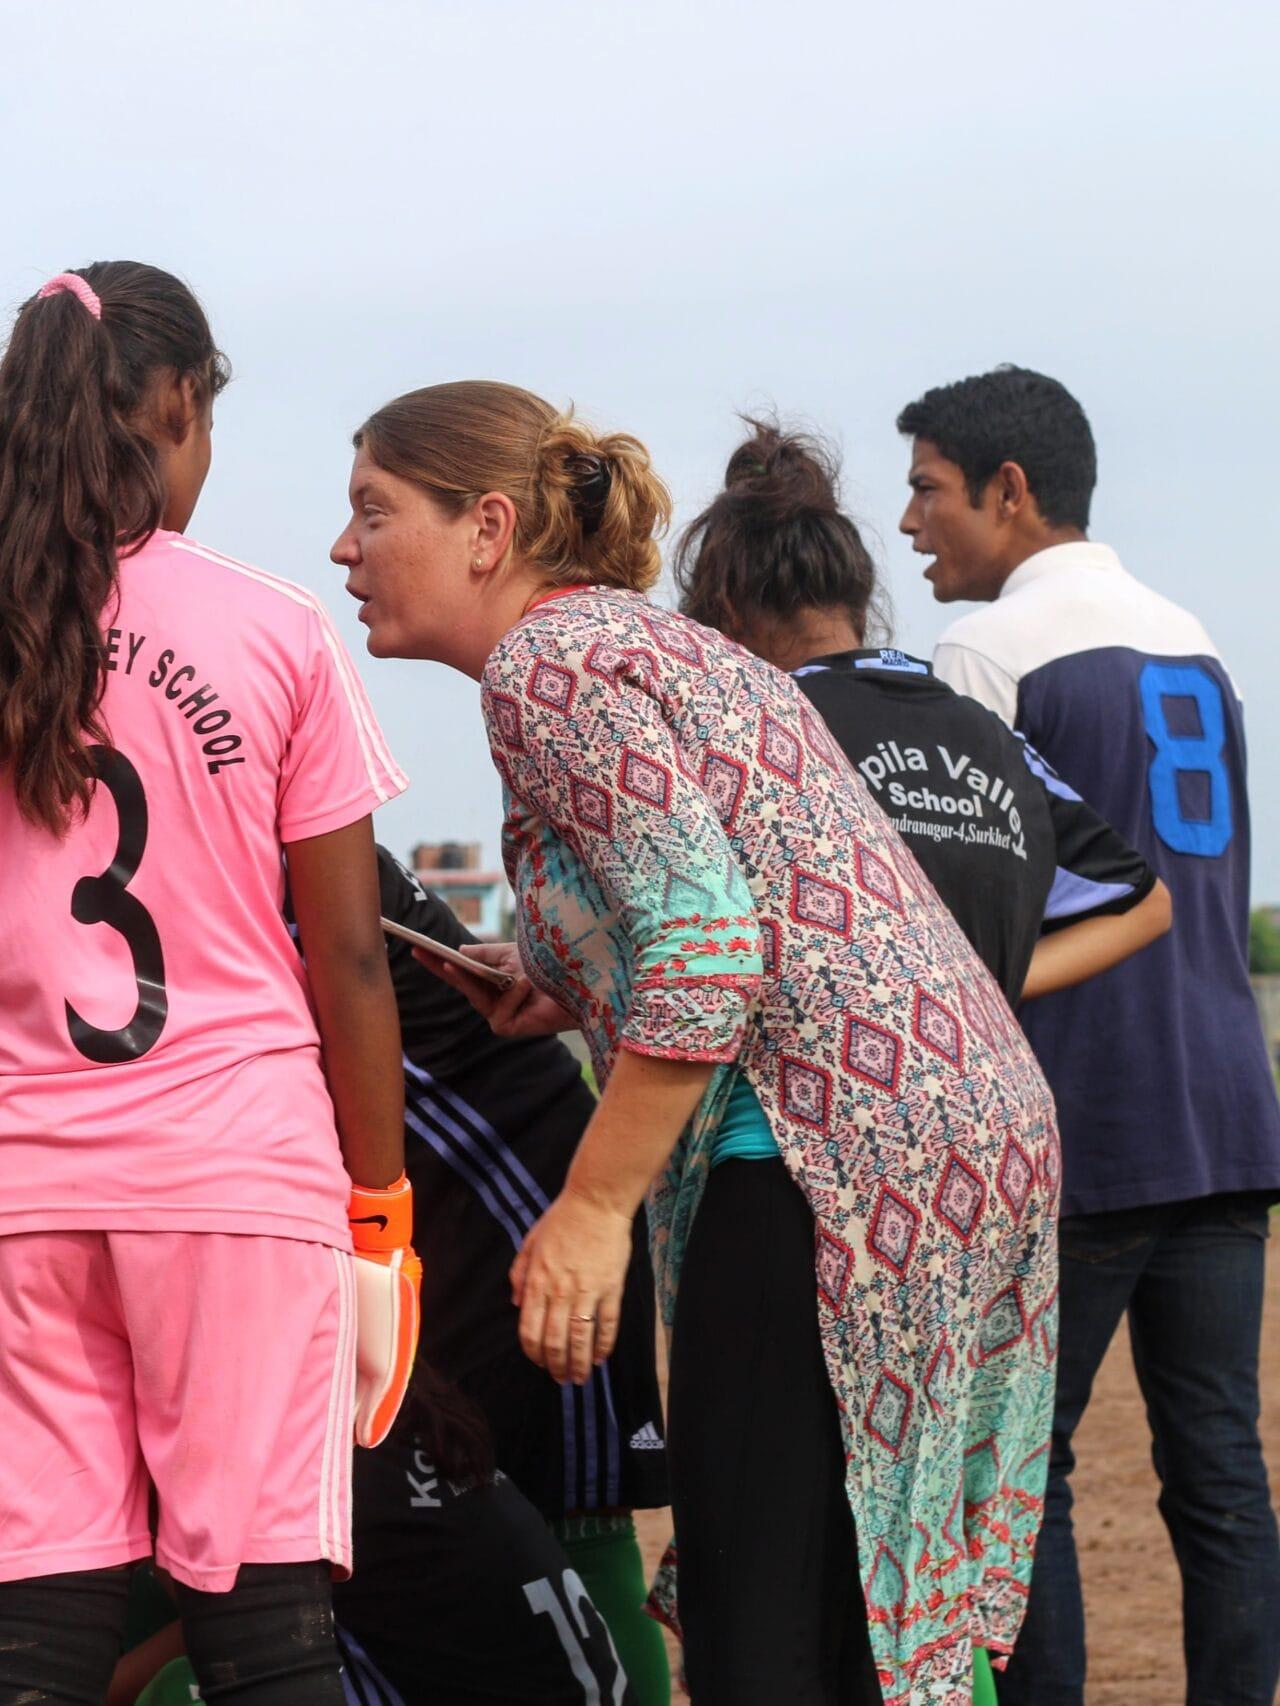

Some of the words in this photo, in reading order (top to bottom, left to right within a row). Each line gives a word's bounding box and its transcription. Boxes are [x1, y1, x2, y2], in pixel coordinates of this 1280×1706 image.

[149, 649, 245, 774] SCHOOL
[1138, 660, 1234, 857] 8
[858, 740, 929, 791] pila
[937, 745, 1027, 861] Valley
[888, 781, 983, 818] School
[890, 813, 1012, 850] ndranagar-4,Surkhet
[65, 744, 169, 1064] 3
[630, 1440, 664, 1449] adidas
